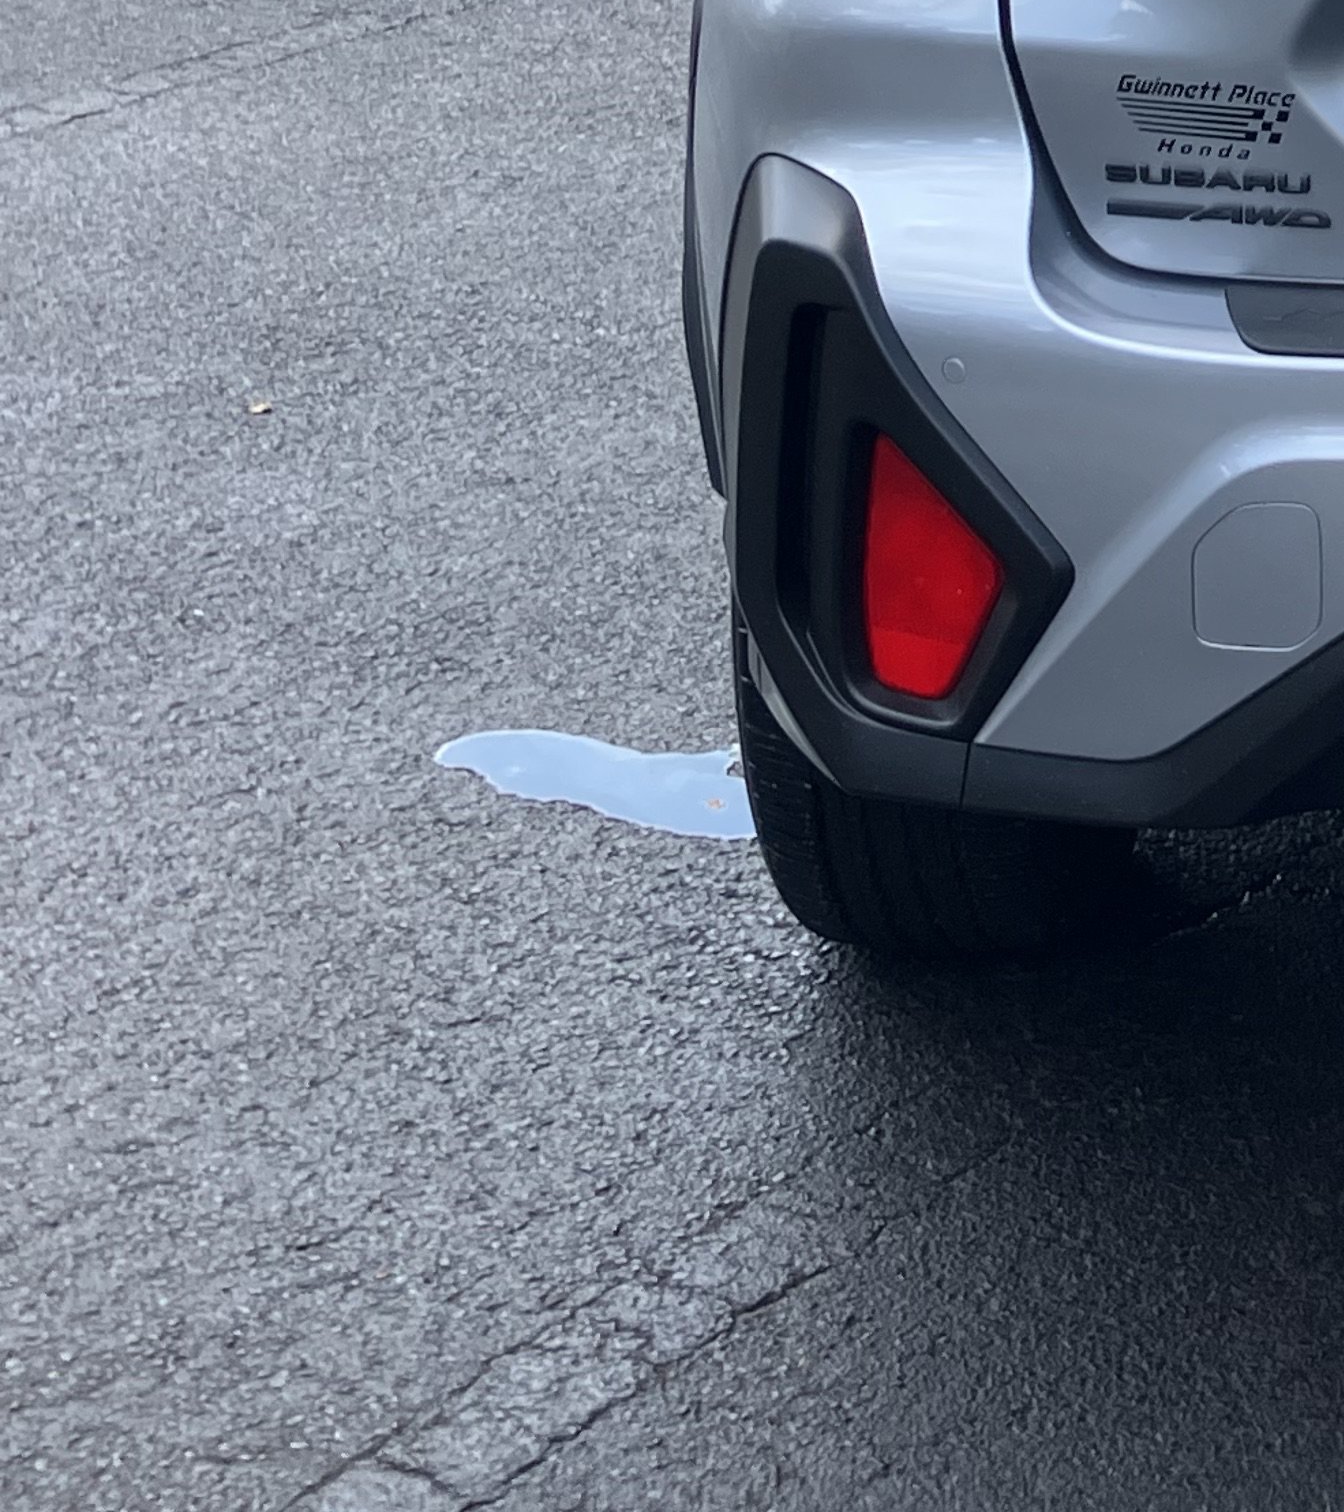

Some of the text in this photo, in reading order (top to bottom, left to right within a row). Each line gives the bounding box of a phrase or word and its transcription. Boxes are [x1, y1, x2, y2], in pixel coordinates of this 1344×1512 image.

[1116, 74, 1297, 109] Gwinnett Place
[1157, 138, 1251, 160] Honda
[1105, 163, 1312, 195] SUBARU
[1189, 202, 1332, 229] AWD
